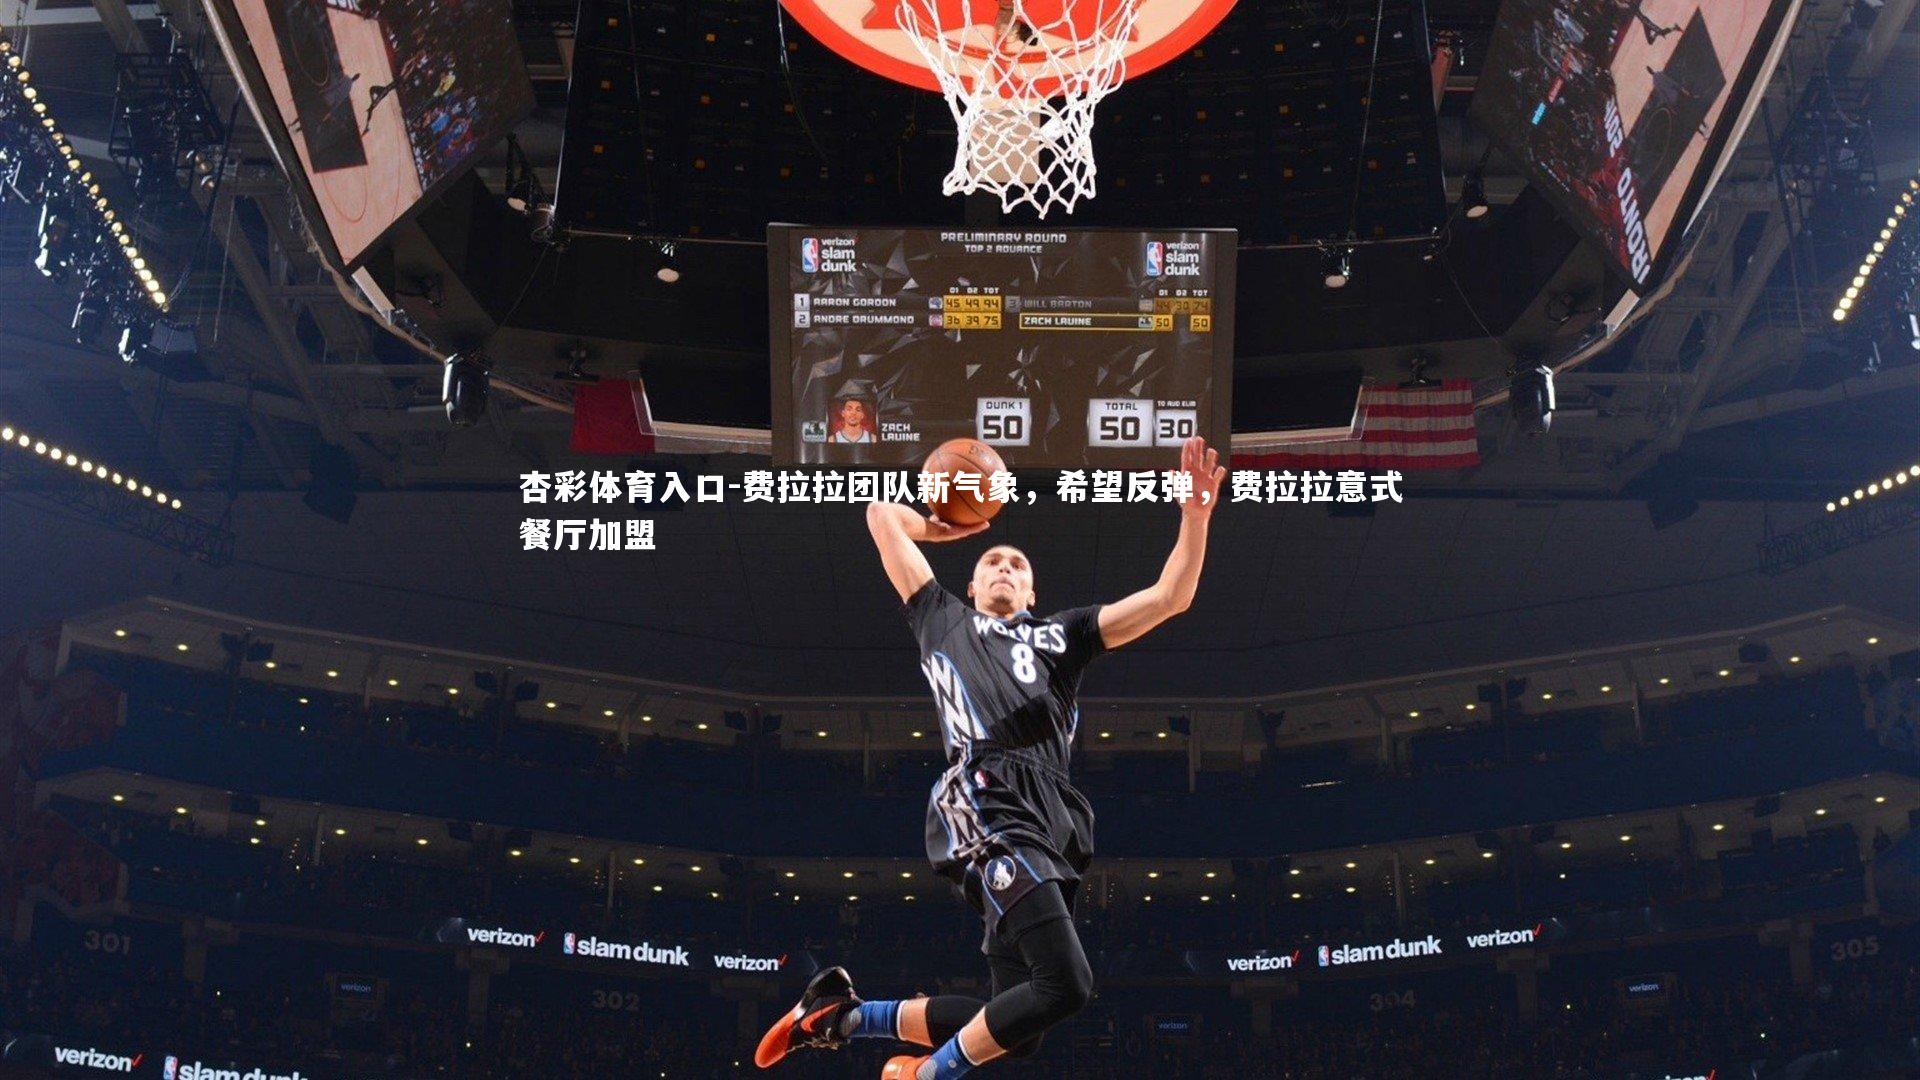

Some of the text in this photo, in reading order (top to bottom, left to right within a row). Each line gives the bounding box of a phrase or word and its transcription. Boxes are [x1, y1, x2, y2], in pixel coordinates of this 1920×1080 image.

[821, 237, 855, 246] verizon
[941, 232, 1067, 243] PRELIMINARY ROUND
[965, 244, 1042, 254] TOP 2 ADVANCE
[1166, 241, 1199, 249] verizon
[821, 246, 855, 259] slam
[1166, 250, 1199, 263] slam
[821, 260, 857, 272] dunk
[1165, 263, 1200, 276] dunk
[813, 298, 850, 307] AARON
[853, 298, 896, 307] GORDON
[946, 298, 960, 308] 45
[965, 298, 980, 308] 49
[984, 298, 999, 308] 94
[1024, 300, 1048, 308] WILL
[1051, 300, 1092, 308] BARTON
[1193, 301, 1209, 310] 74
[799, 315, 999, 325] 2 ANDRE DRUMMOND 36 39 75
[1024, 317, 1208, 328] ZACH LAVINE 50 50
[986, 401, 1024, 410] DUNK 1
[1106, 402, 1138, 410] TOTAL
[881, 423, 911, 432] ZACH
[983, 415, 1023, 439] 50
[1100, 416, 1140, 441] 50
[1159, 419, 1193, 438] 30
[881, 433, 920, 442] LAVINE
[1011, 643, 1037, 684] 8
[84, 930, 132, 955] 301
[1830, 936, 1879, 961] 305
[467, 927, 779, 971] verizon slam dunk verizon
[1227, 927, 1534, 971] verizon slam dunk verizon
[341, 981, 372, 993] verizon
[1628, 982, 1659, 993] verizon
[592, 989, 639, 1010] 302
[1369, 990, 1415, 1011] 304
[54, 1046, 133, 1072] verizon
